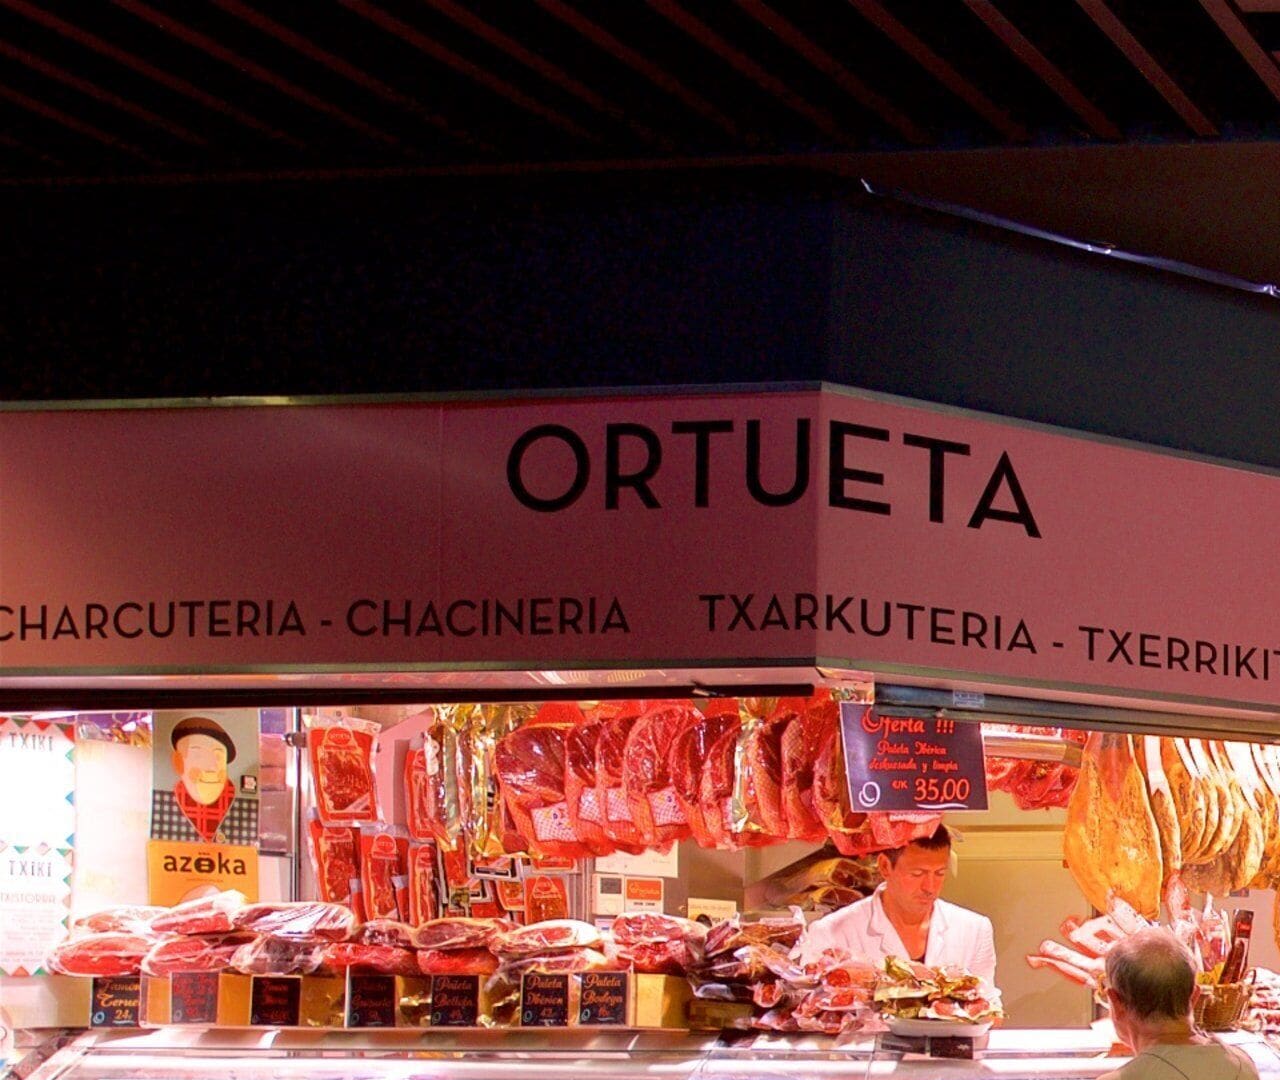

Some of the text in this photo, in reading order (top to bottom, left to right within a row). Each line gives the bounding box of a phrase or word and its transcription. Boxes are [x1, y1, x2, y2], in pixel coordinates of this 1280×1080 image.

[506, 418, 1042, 539] ORTUETA
[0, 598, 306, 643] CHARCUTERIA
[347, 596, 630, 639] CHACINERIA
[699, 593, 1037, 656] TXARKUTERIA
[914, 778, 971, 803] 35,00
